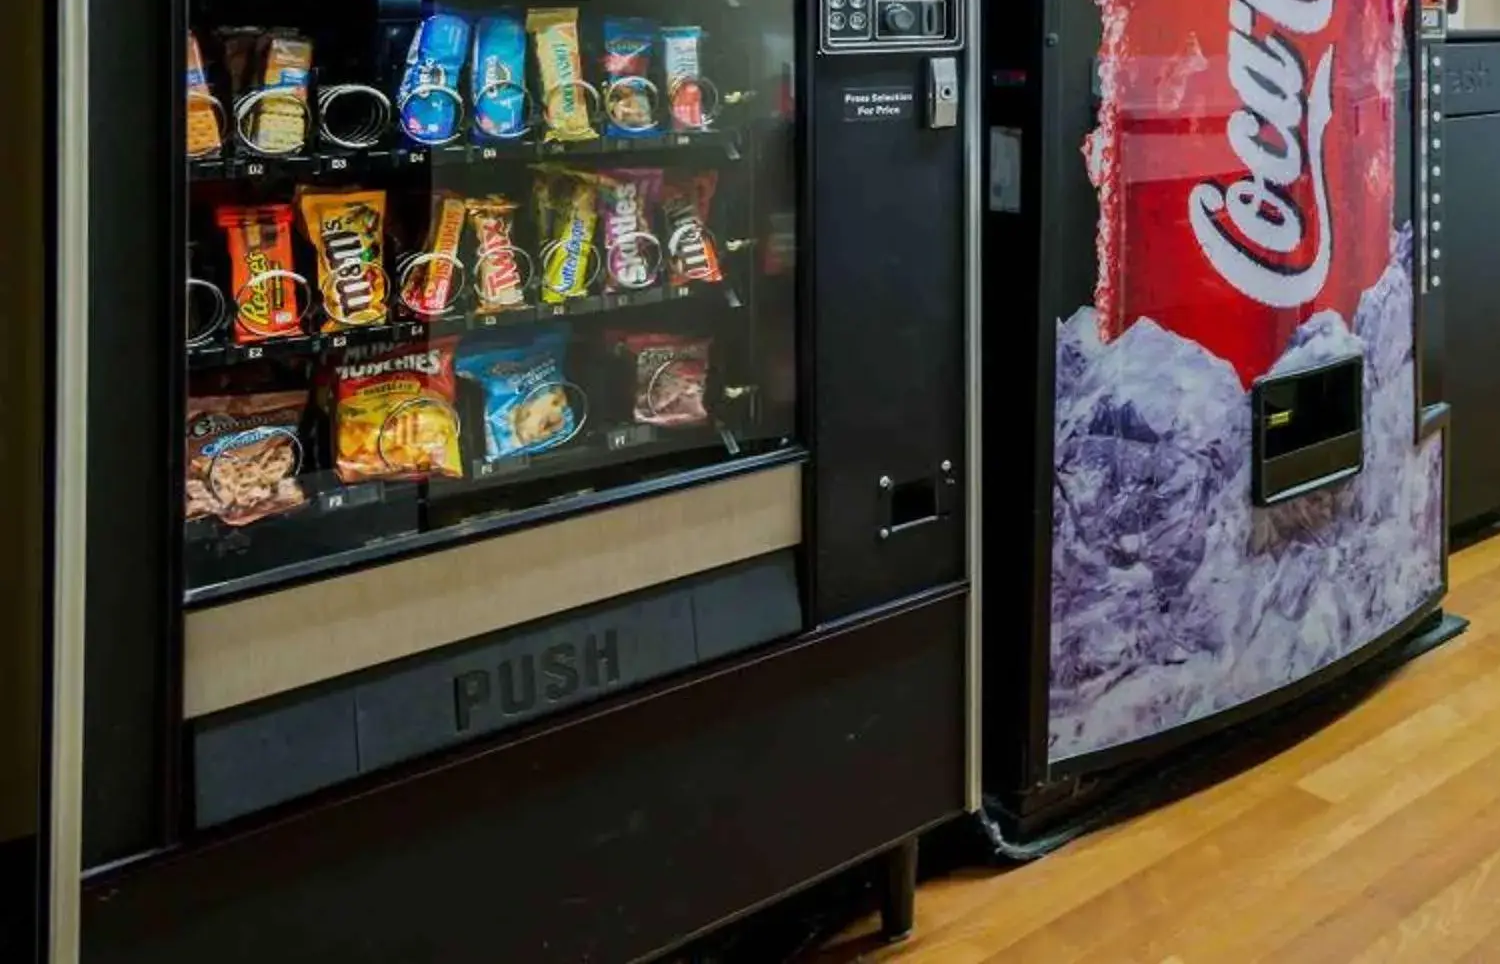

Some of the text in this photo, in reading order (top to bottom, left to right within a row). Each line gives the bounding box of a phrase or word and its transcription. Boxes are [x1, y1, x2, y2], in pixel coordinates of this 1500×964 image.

[875, 105, 901, 116] Price
[248, 164, 264, 175] D2
[452, 627, 621, 732] PUSH
